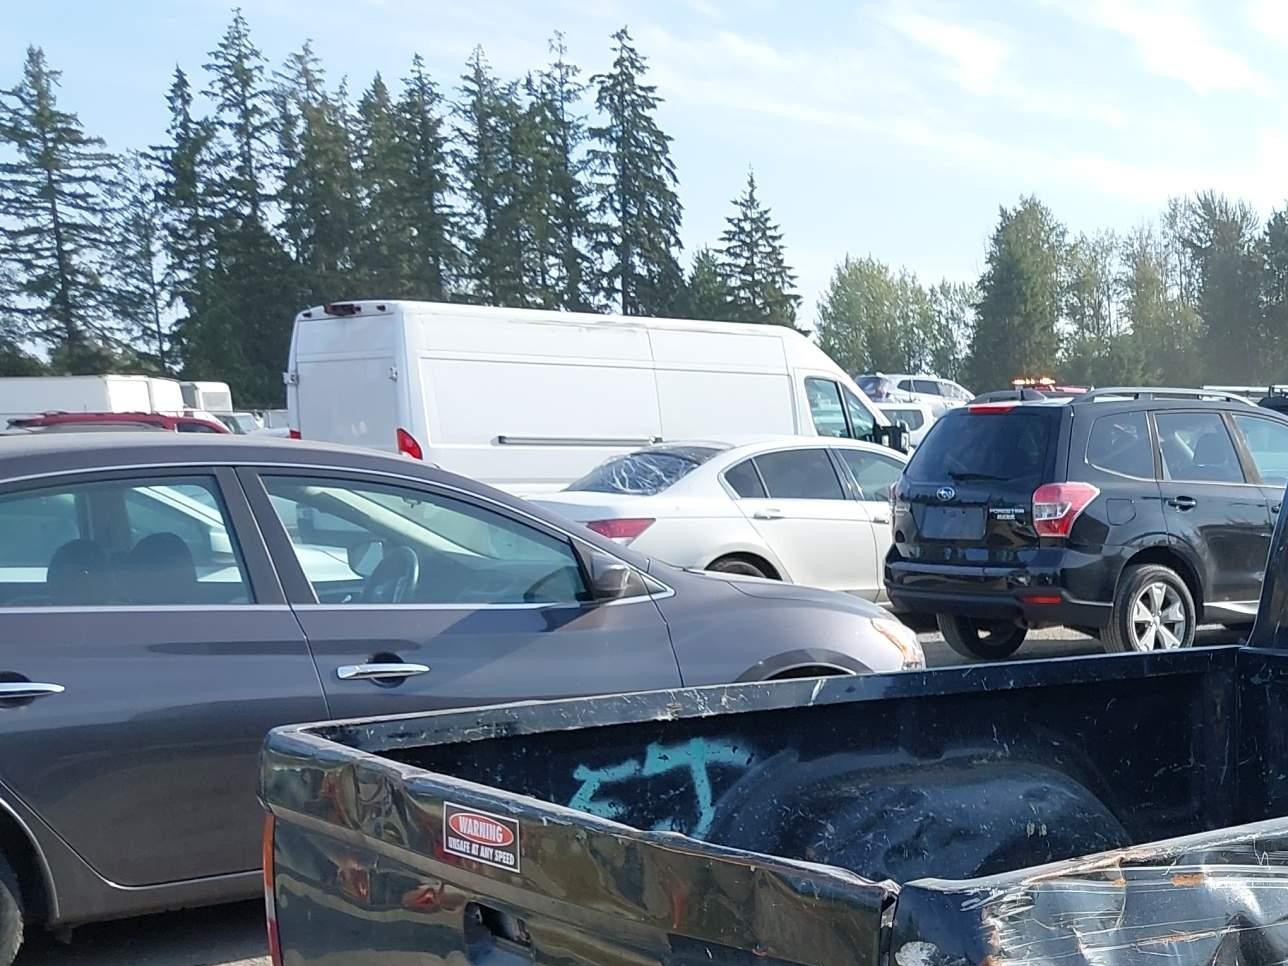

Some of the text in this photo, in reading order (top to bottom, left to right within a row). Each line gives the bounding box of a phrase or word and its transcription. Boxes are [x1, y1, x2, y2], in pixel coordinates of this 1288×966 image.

[459, 816, 503, 843] WARNING
[447, 836, 515, 865] UNSAFE AT ANY SPEED
